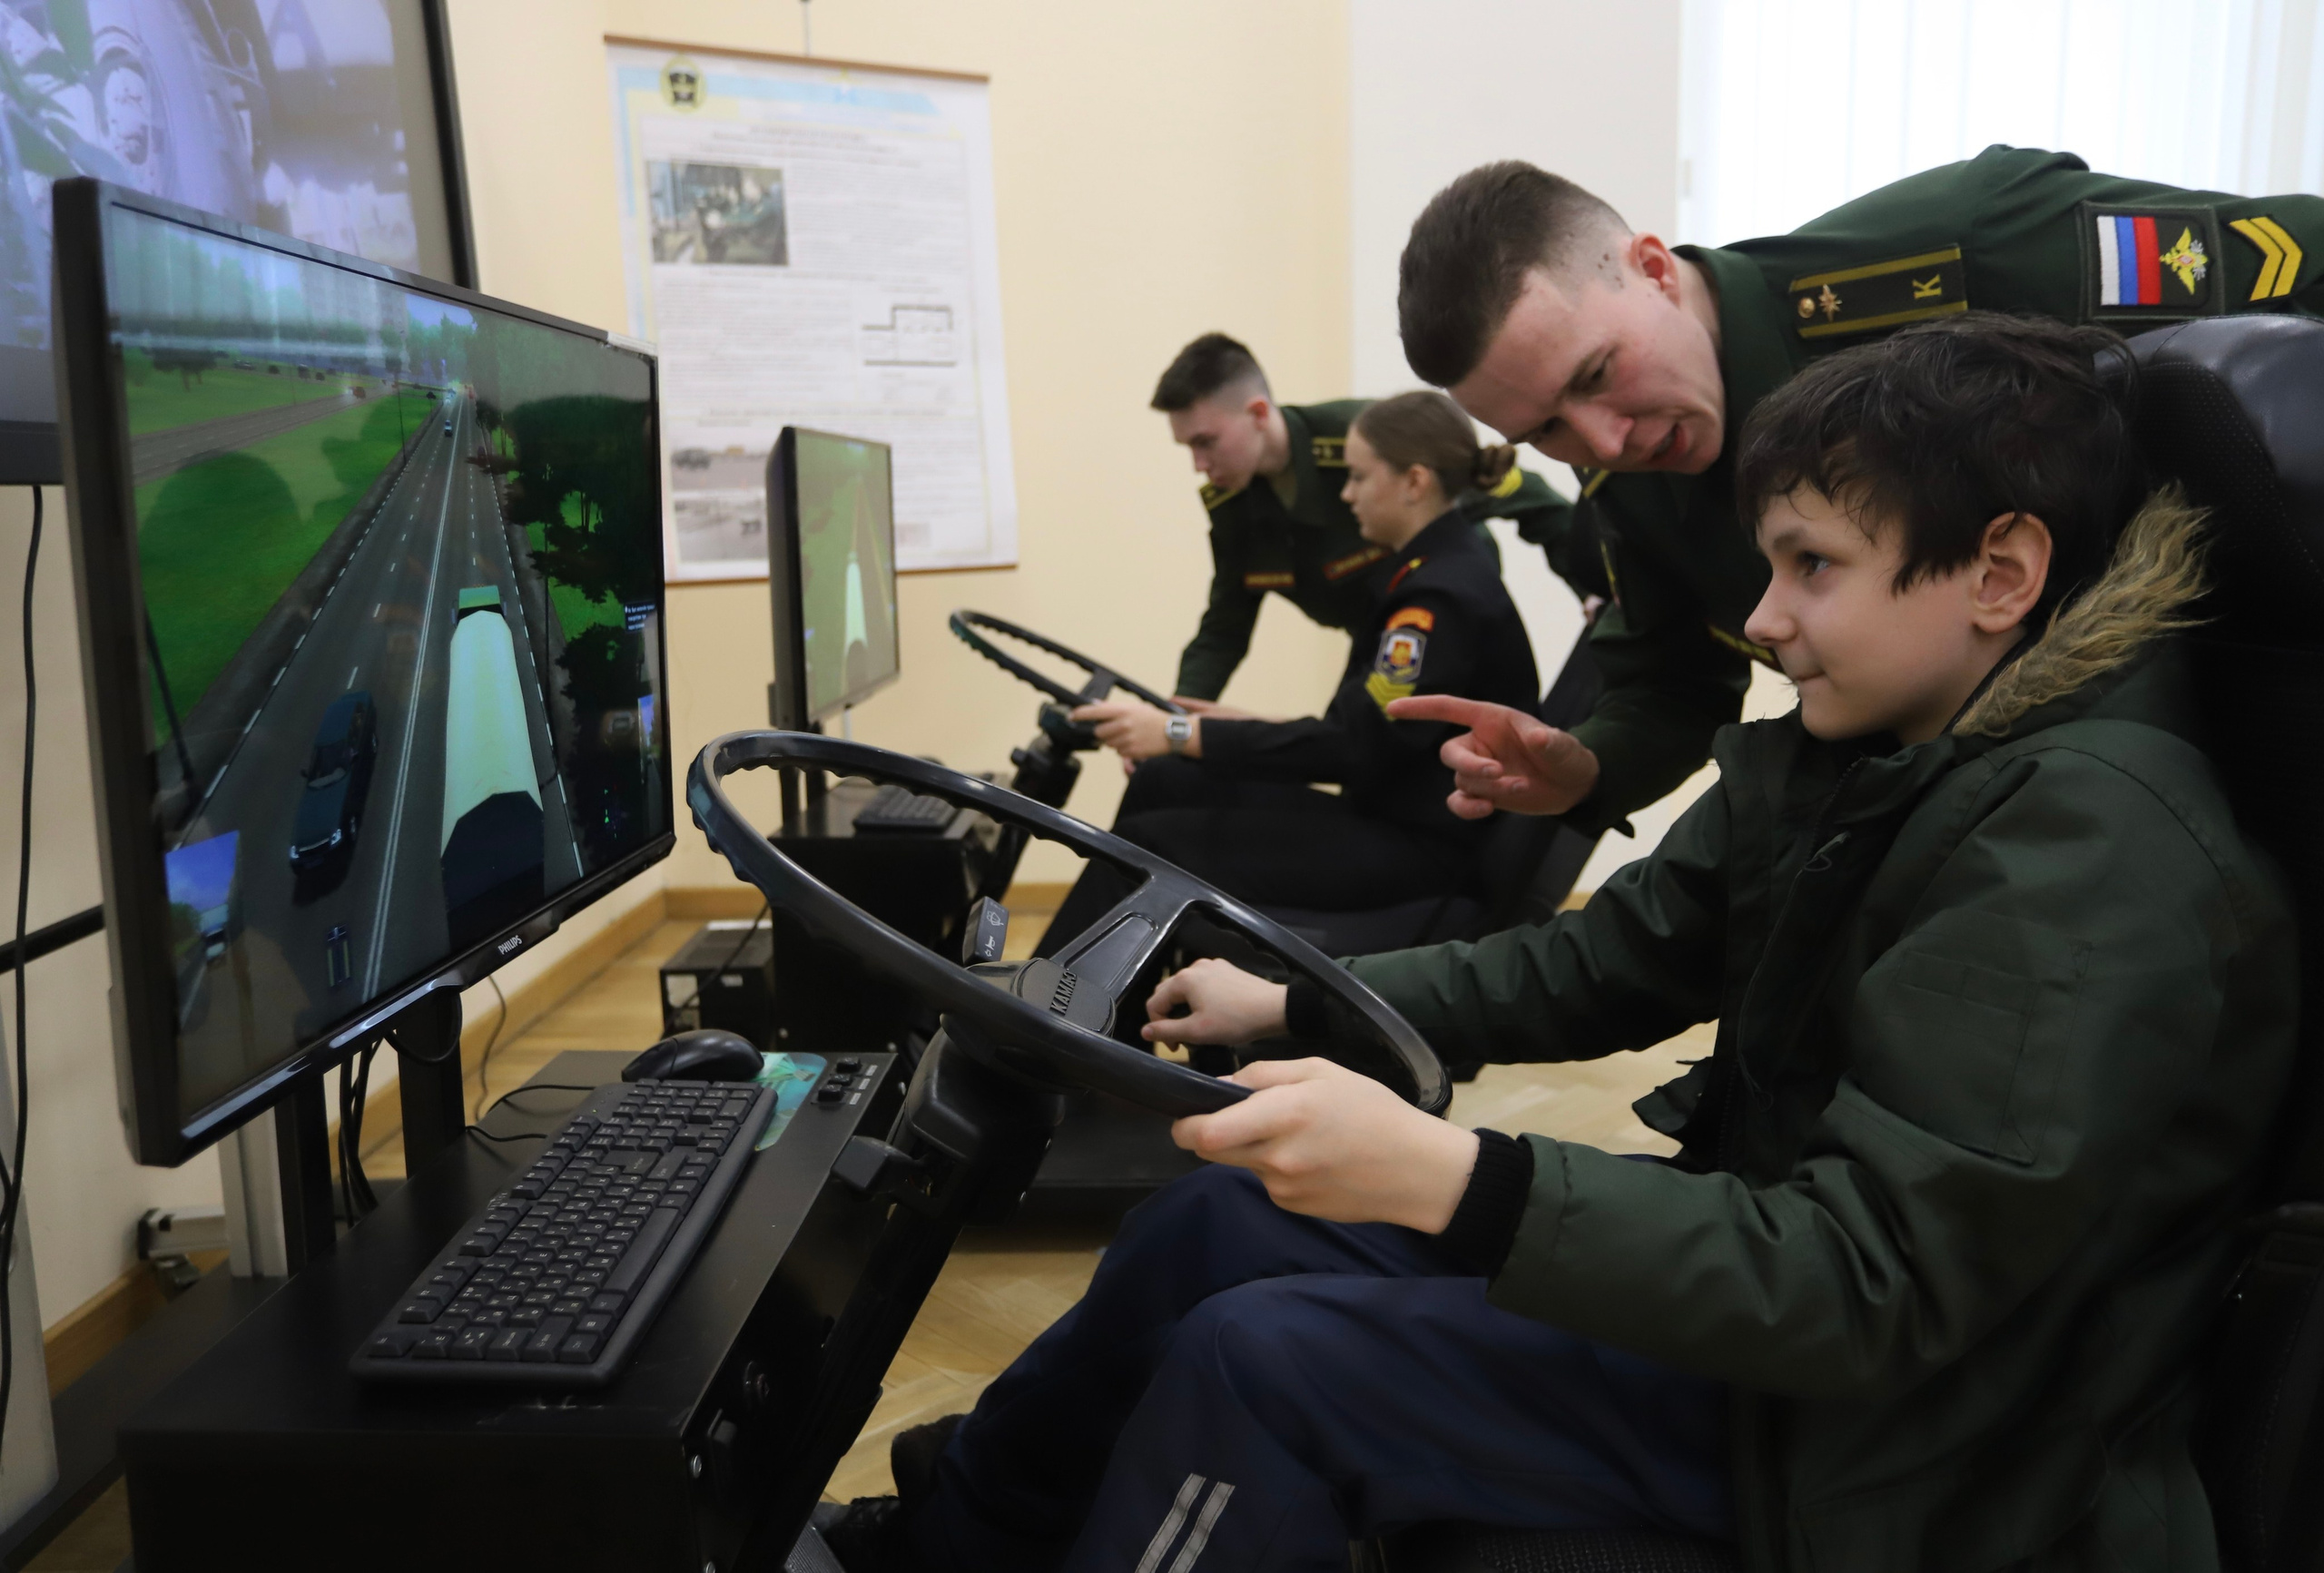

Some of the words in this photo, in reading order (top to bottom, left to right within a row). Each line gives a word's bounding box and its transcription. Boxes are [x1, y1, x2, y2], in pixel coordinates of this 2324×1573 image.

[1912, 274, 1942, 299] К
[497, 934, 523, 955] PHILIPS
[1050, 970, 1077, 1017] КАМАЗ
